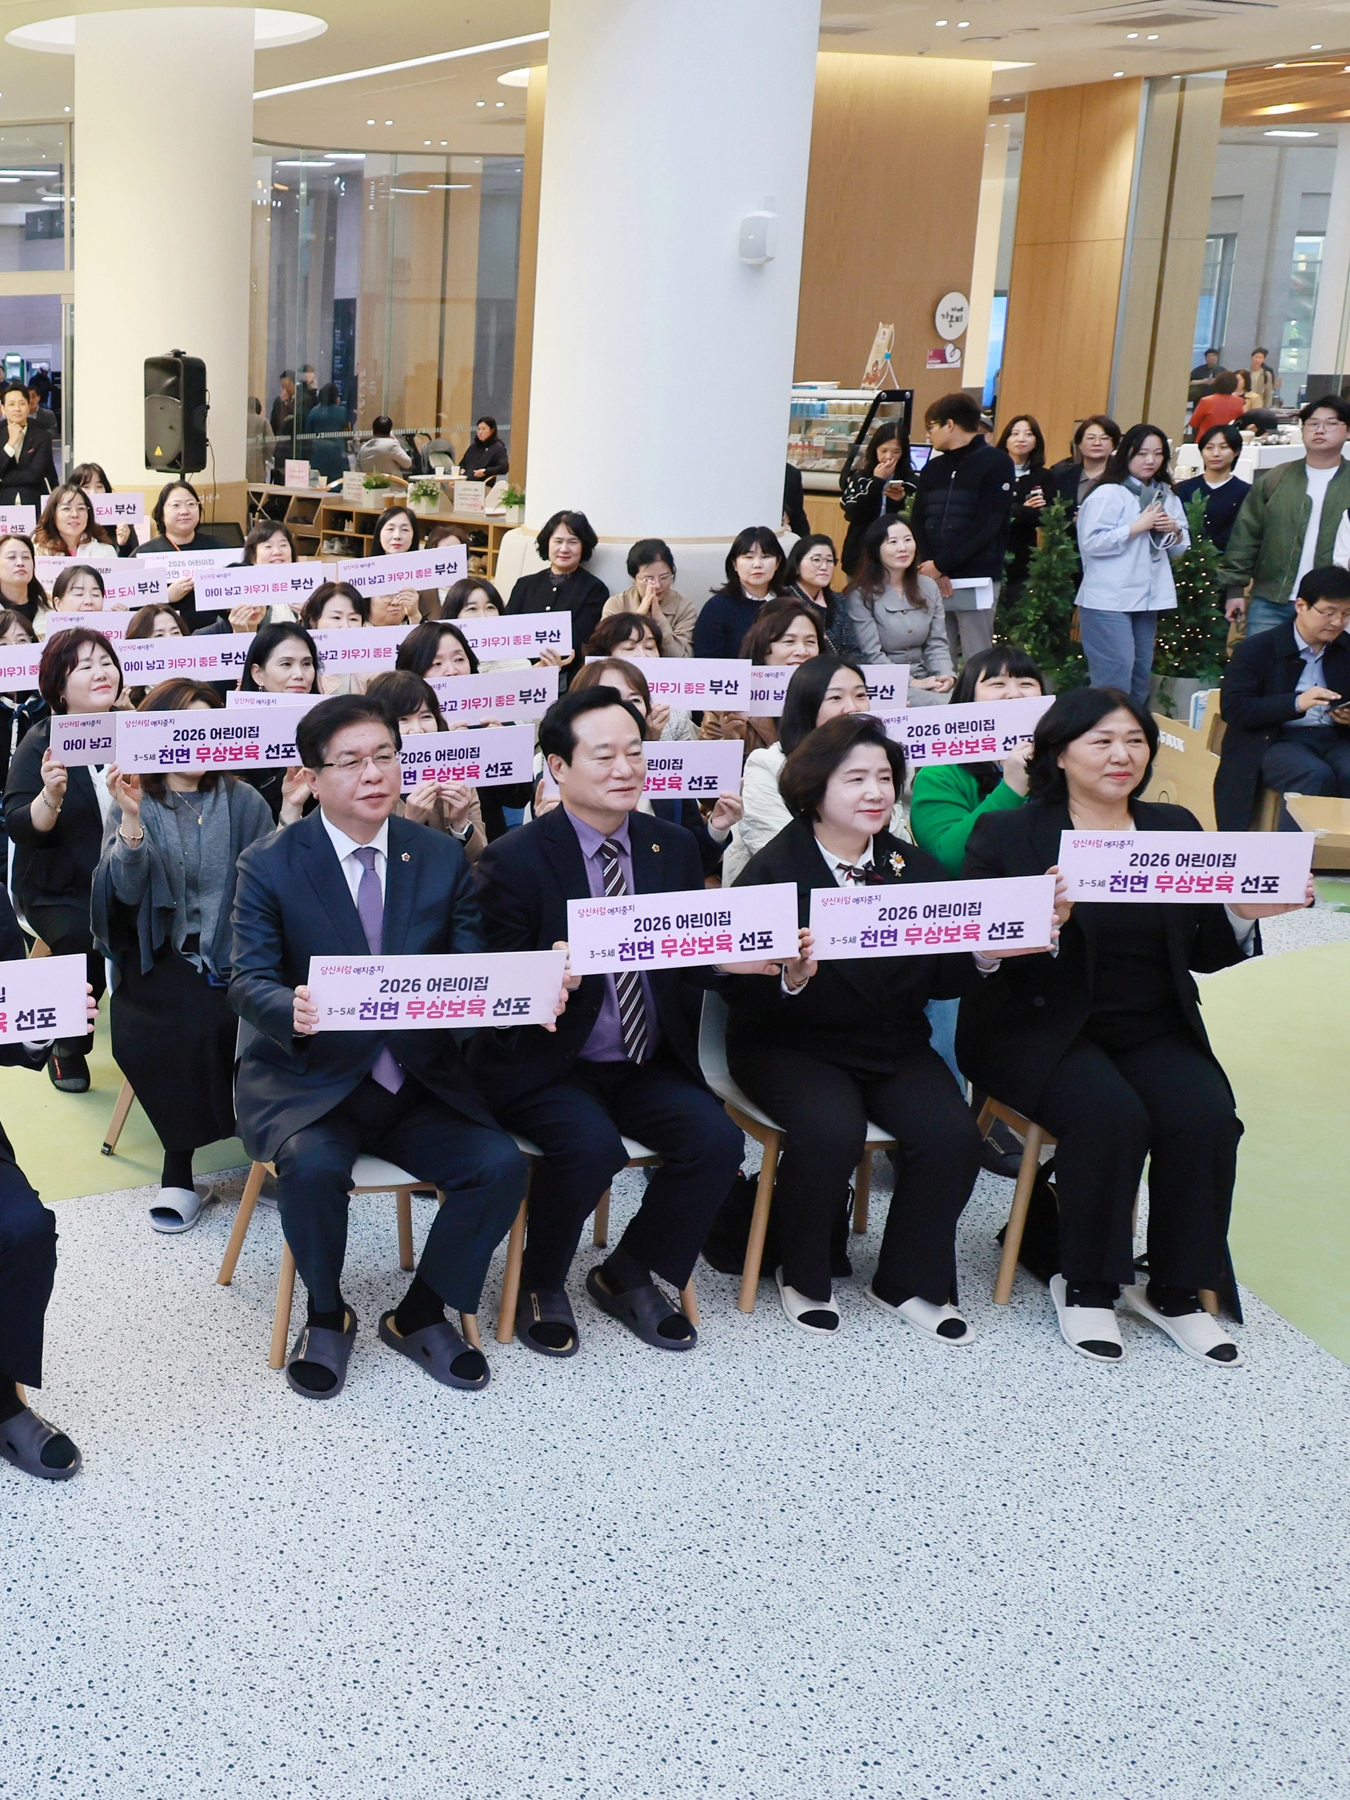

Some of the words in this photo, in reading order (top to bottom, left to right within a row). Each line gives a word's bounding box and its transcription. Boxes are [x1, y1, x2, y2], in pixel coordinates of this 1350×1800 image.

[10, 525, 25, 533] 선포
[349, 576, 366, 586] 아이
[368, 574, 385, 584] 낳고
[387, 571, 413, 582] 키우기
[416, 568, 432, 579] 좋은
[434, 561, 457, 575] 부산
[205, 587, 222, 597] 아이
[224, 586, 241, 595] 낳고
[244, 584, 269, 594] 키우기
[271, 582, 288, 592] 좋은
[291, 577, 313, 590] 부산
[481, 636, 510, 647] 키우기
[513, 634, 531, 645] 좋은
[535, 630, 560, 644] 부산
[124, 660, 143, 672] 아이
[145, 658, 164, 670] 낳고
[168, 657, 196, 668] 키우기
[199, 656, 218, 667] 좋은
[220, 652, 246, 666] 부산
[649, 682, 680, 694] 키우기
[684, 682, 705, 694] 좋은
[710, 680, 738, 695] 부산
[461, 697, 492, 709] 키우기
[495, 695, 515, 707] 좋은
[519, 688, 546, 705] 부산
[173, 729, 206, 741] 2026
[210, 726, 259, 739] 어린이집
[907, 725, 940, 737] 2026
[945, 719, 995, 734] 어린이집
[159, 748, 190, 765] 전면
[196, 744, 259, 762] 무상보육
[265, 743, 296, 759] 선포
[402, 750, 431, 764] 2026
[435, 747, 480, 762] 어린이집
[931, 737, 996, 757] 무상보육
[422, 764, 479, 783] 무상보육
[485, 762, 513, 778] 선포
[1072, 839, 1102, 848] 당신처럼
[1104, 840, 1134, 849] 애지중지
[1130, 854, 1170, 867] 2026
[1175, 853, 1236, 867] 어린이집
[1078, 879, 1105, 888] 3~5세
[1109, 875, 1148, 893] 전면
[1155, 875, 1234, 894] 무상보육
[1241, 876, 1279, 893] 선포
[822, 896, 850, 906] 당신처럼
[852, 895, 881, 905] 애지중지
[578, 907, 606, 918] 당신처럼
[608, 905, 635, 915] 애지중지
[878, 906, 917, 921] 2026
[923, 902, 982, 918] 어린이집
[634, 916, 671, 932] 2026
[676, 911, 731, 929] 어린이집
[830, 936, 856, 945] 3~5세
[860, 929, 898, 948] 전면
[905, 924, 981, 945] 무상보육
[988, 921, 1024, 940] 선포
[590, 949, 615, 958] 3~5세
[618, 940, 654, 962] 전면
[661, 934, 732, 958] 무상보육
[739, 931, 773, 951] 선포
[321, 966, 351, 975] 당신처럼
[353, 965, 384, 975] 애지중지
[380, 979, 421, 993] 2026
[427, 976, 488, 992] 어린이집
[327, 1008, 355, 1016] 3~5세
[359, 1001, 399, 1020] 전면
[406, 998, 485, 1019] 무상보육
[492, 997, 531, 1016] 선포
[15, 1008, 56, 1030] 선포
